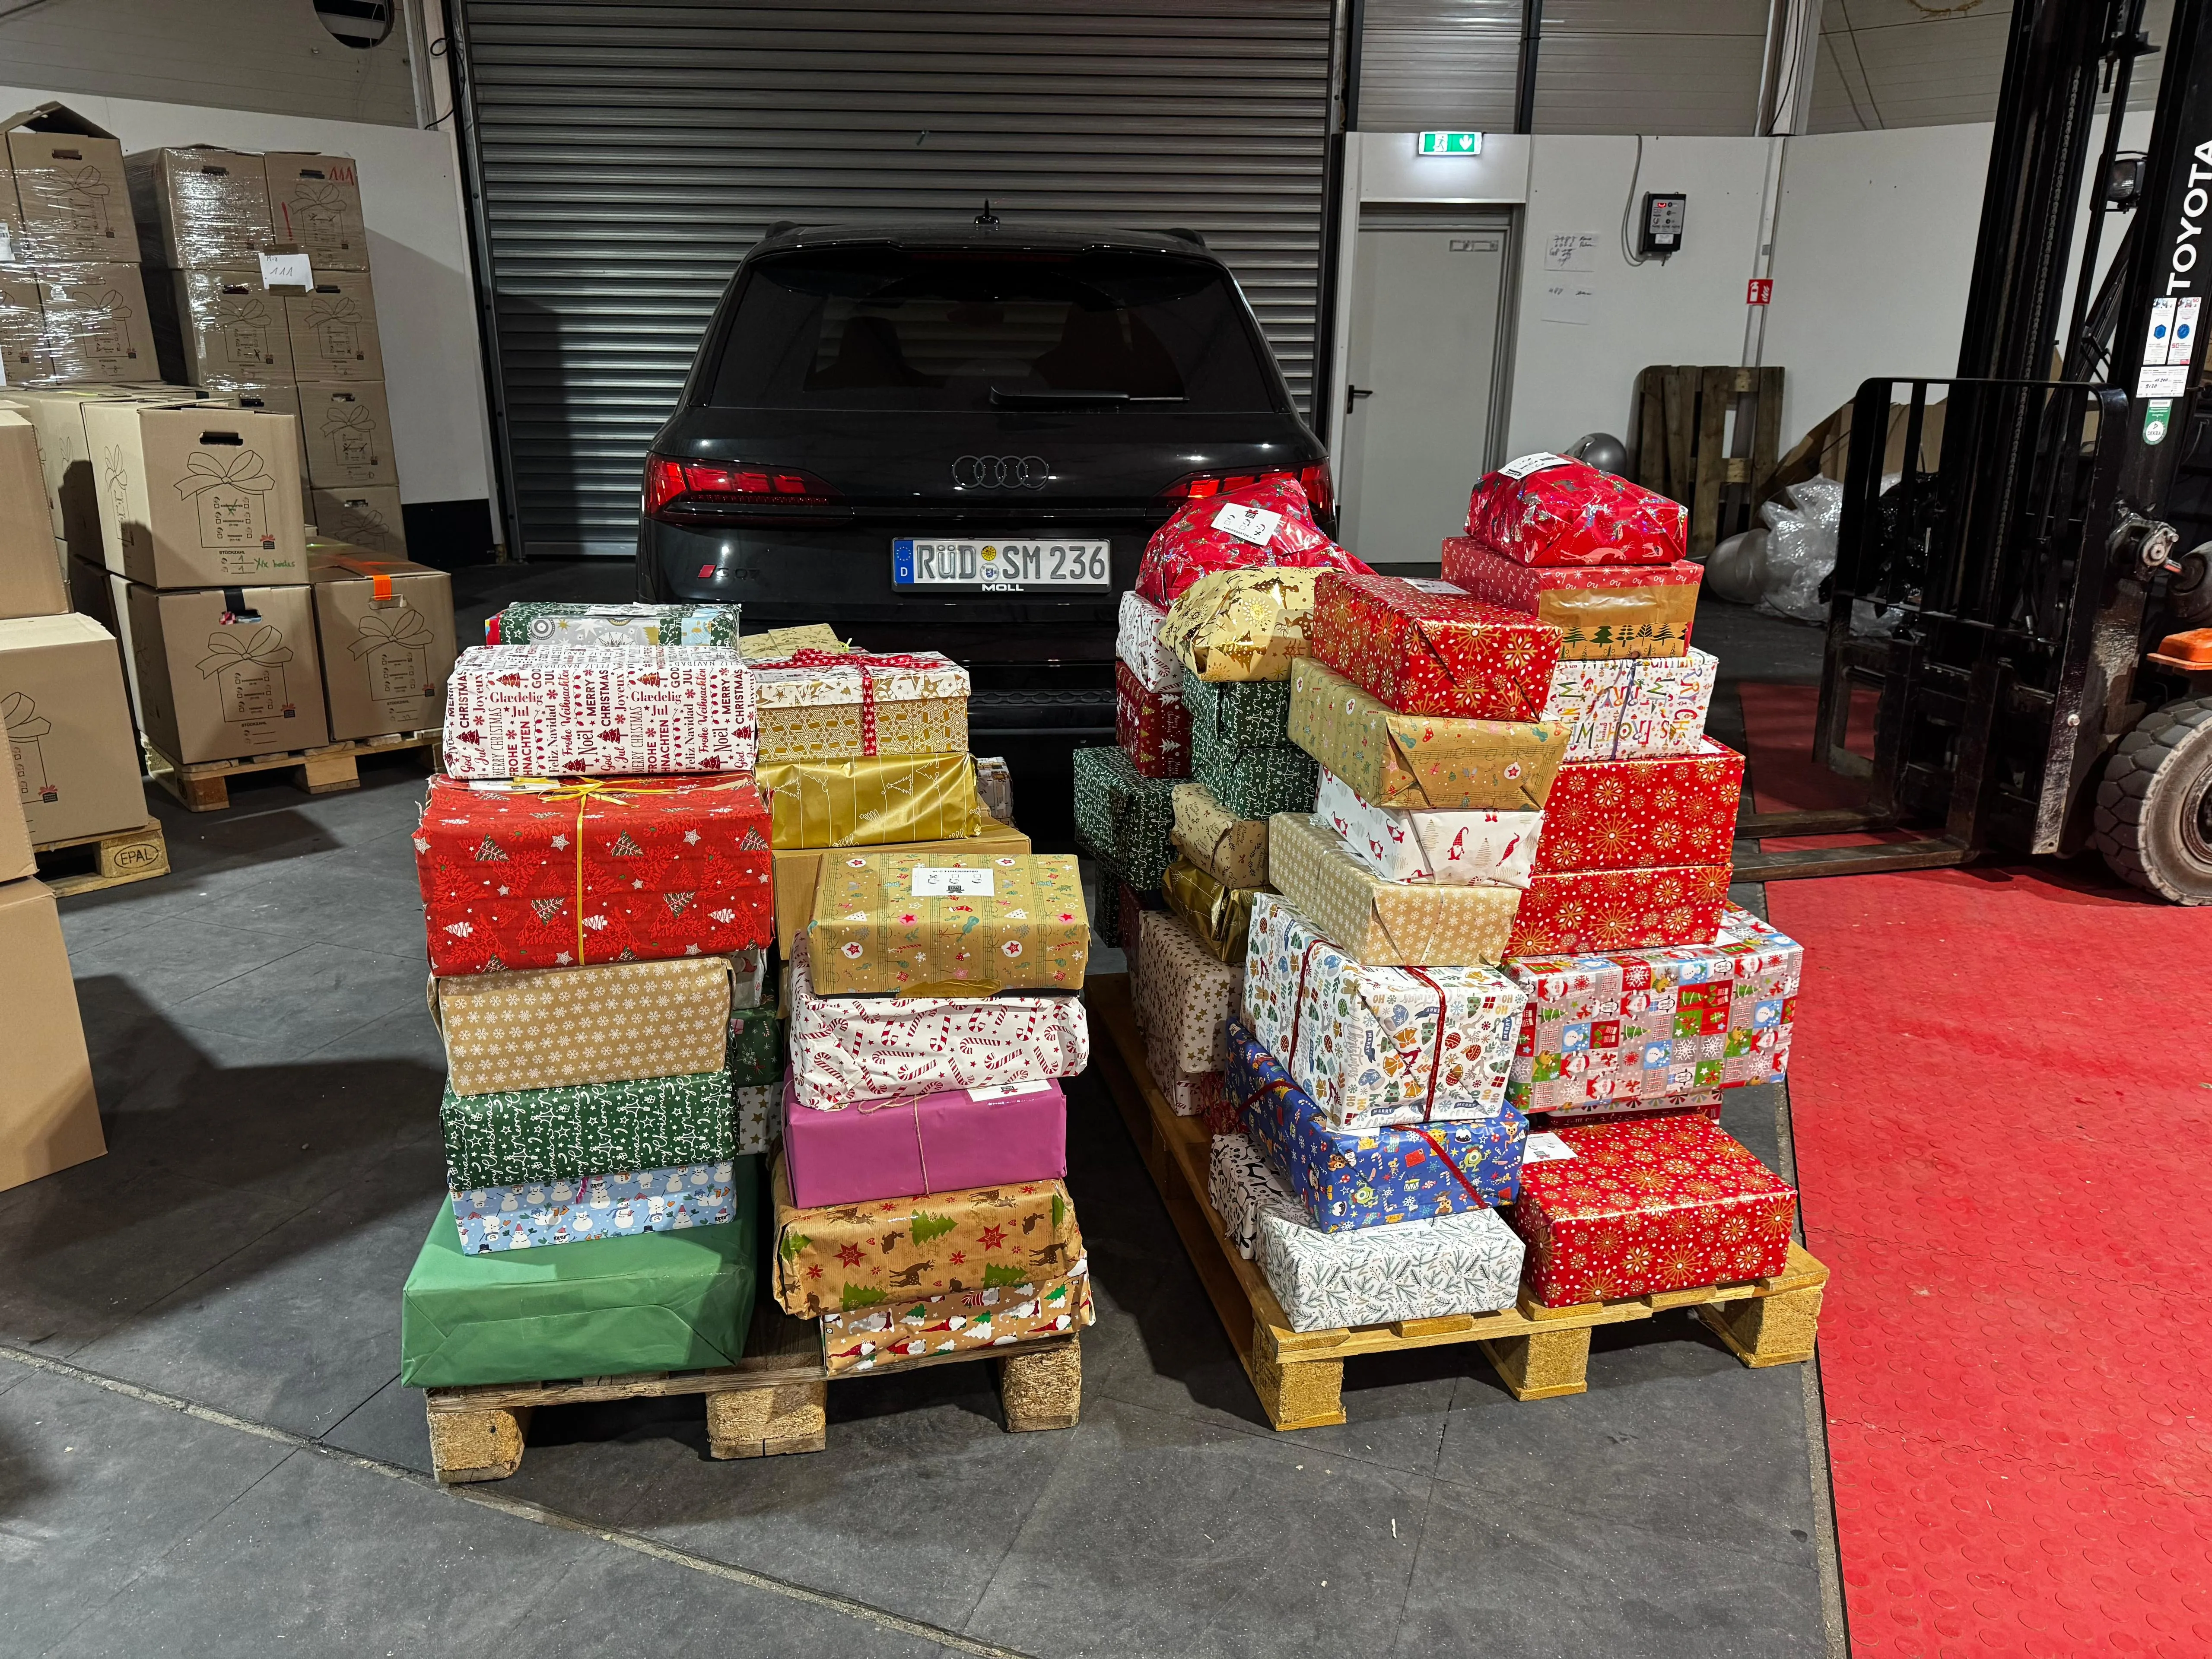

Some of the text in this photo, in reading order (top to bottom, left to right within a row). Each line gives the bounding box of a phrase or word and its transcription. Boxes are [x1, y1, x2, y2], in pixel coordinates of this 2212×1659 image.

[2166, 140, 2212, 296] TOYOTA
[900, 567, 908, 577] D
[916, 545, 1105, 579] RÜD SM 236
[531, 669, 542, 689] GOD
[545, 670, 555, 685] JUL
[670, 667, 680, 688] GOD
[683, 669, 692, 685] JUL
[457, 670, 470, 728] CHRISTMAS
[473, 674, 487, 713] Joyeux
[490, 692, 543, 706] Glædelig
[585, 670, 611, 727] MERRY CHRISTMAS
[614, 674, 629, 712] Joyeux
[631, 691, 682, 705] Glædelig
[721, 669, 745, 724] MERRY CHRISTMAS
[512, 706, 529, 718] Jul
[558, 670, 573, 756] Frohe Weihnachten
[651, 705, 668, 716] Jul
[696, 669, 709, 753] Frohe Weihnachten
[488, 708, 505, 776] MERRY CHRISTMAS
[545, 705, 559, 773] Feliz Navidad
[576, 730, 598, 756] Noël
[629, 706, 644, 773] MERRY CHRISTMAS
[683, 704, 696, 770] Feliz Navidad
[712, 728, 732, 753] Noël
[460, 754, 476, 773] God
[474, 747, 489, 766] Jul
[507, 744, 519, 776] FROHE
[601, 754, 616, 772] God
[614, 746, 629, 763] Jul
[647, 742, 657, 773] FROHE
[734, 751, 748, 769] God
[120, 849, 153, 865] EPAL
[1373, 994, 1385, 1004] HO
[1502, 995, 1513, 1003] HO
[1495, 1005, 1508, 1015] HO
[1503, 1017, 1511, 1039] MERRY
[1347, 1096, 1356, 1107] HO
[1357, 1098, 1367, 1111] HO
[1481, 1089, 1492, 1101] HO
[567, 1085, 584, 1162] Christmas
[652, 1077, 668, 1152] Christmas
[480, 1093, 498, 1170] Christmas
